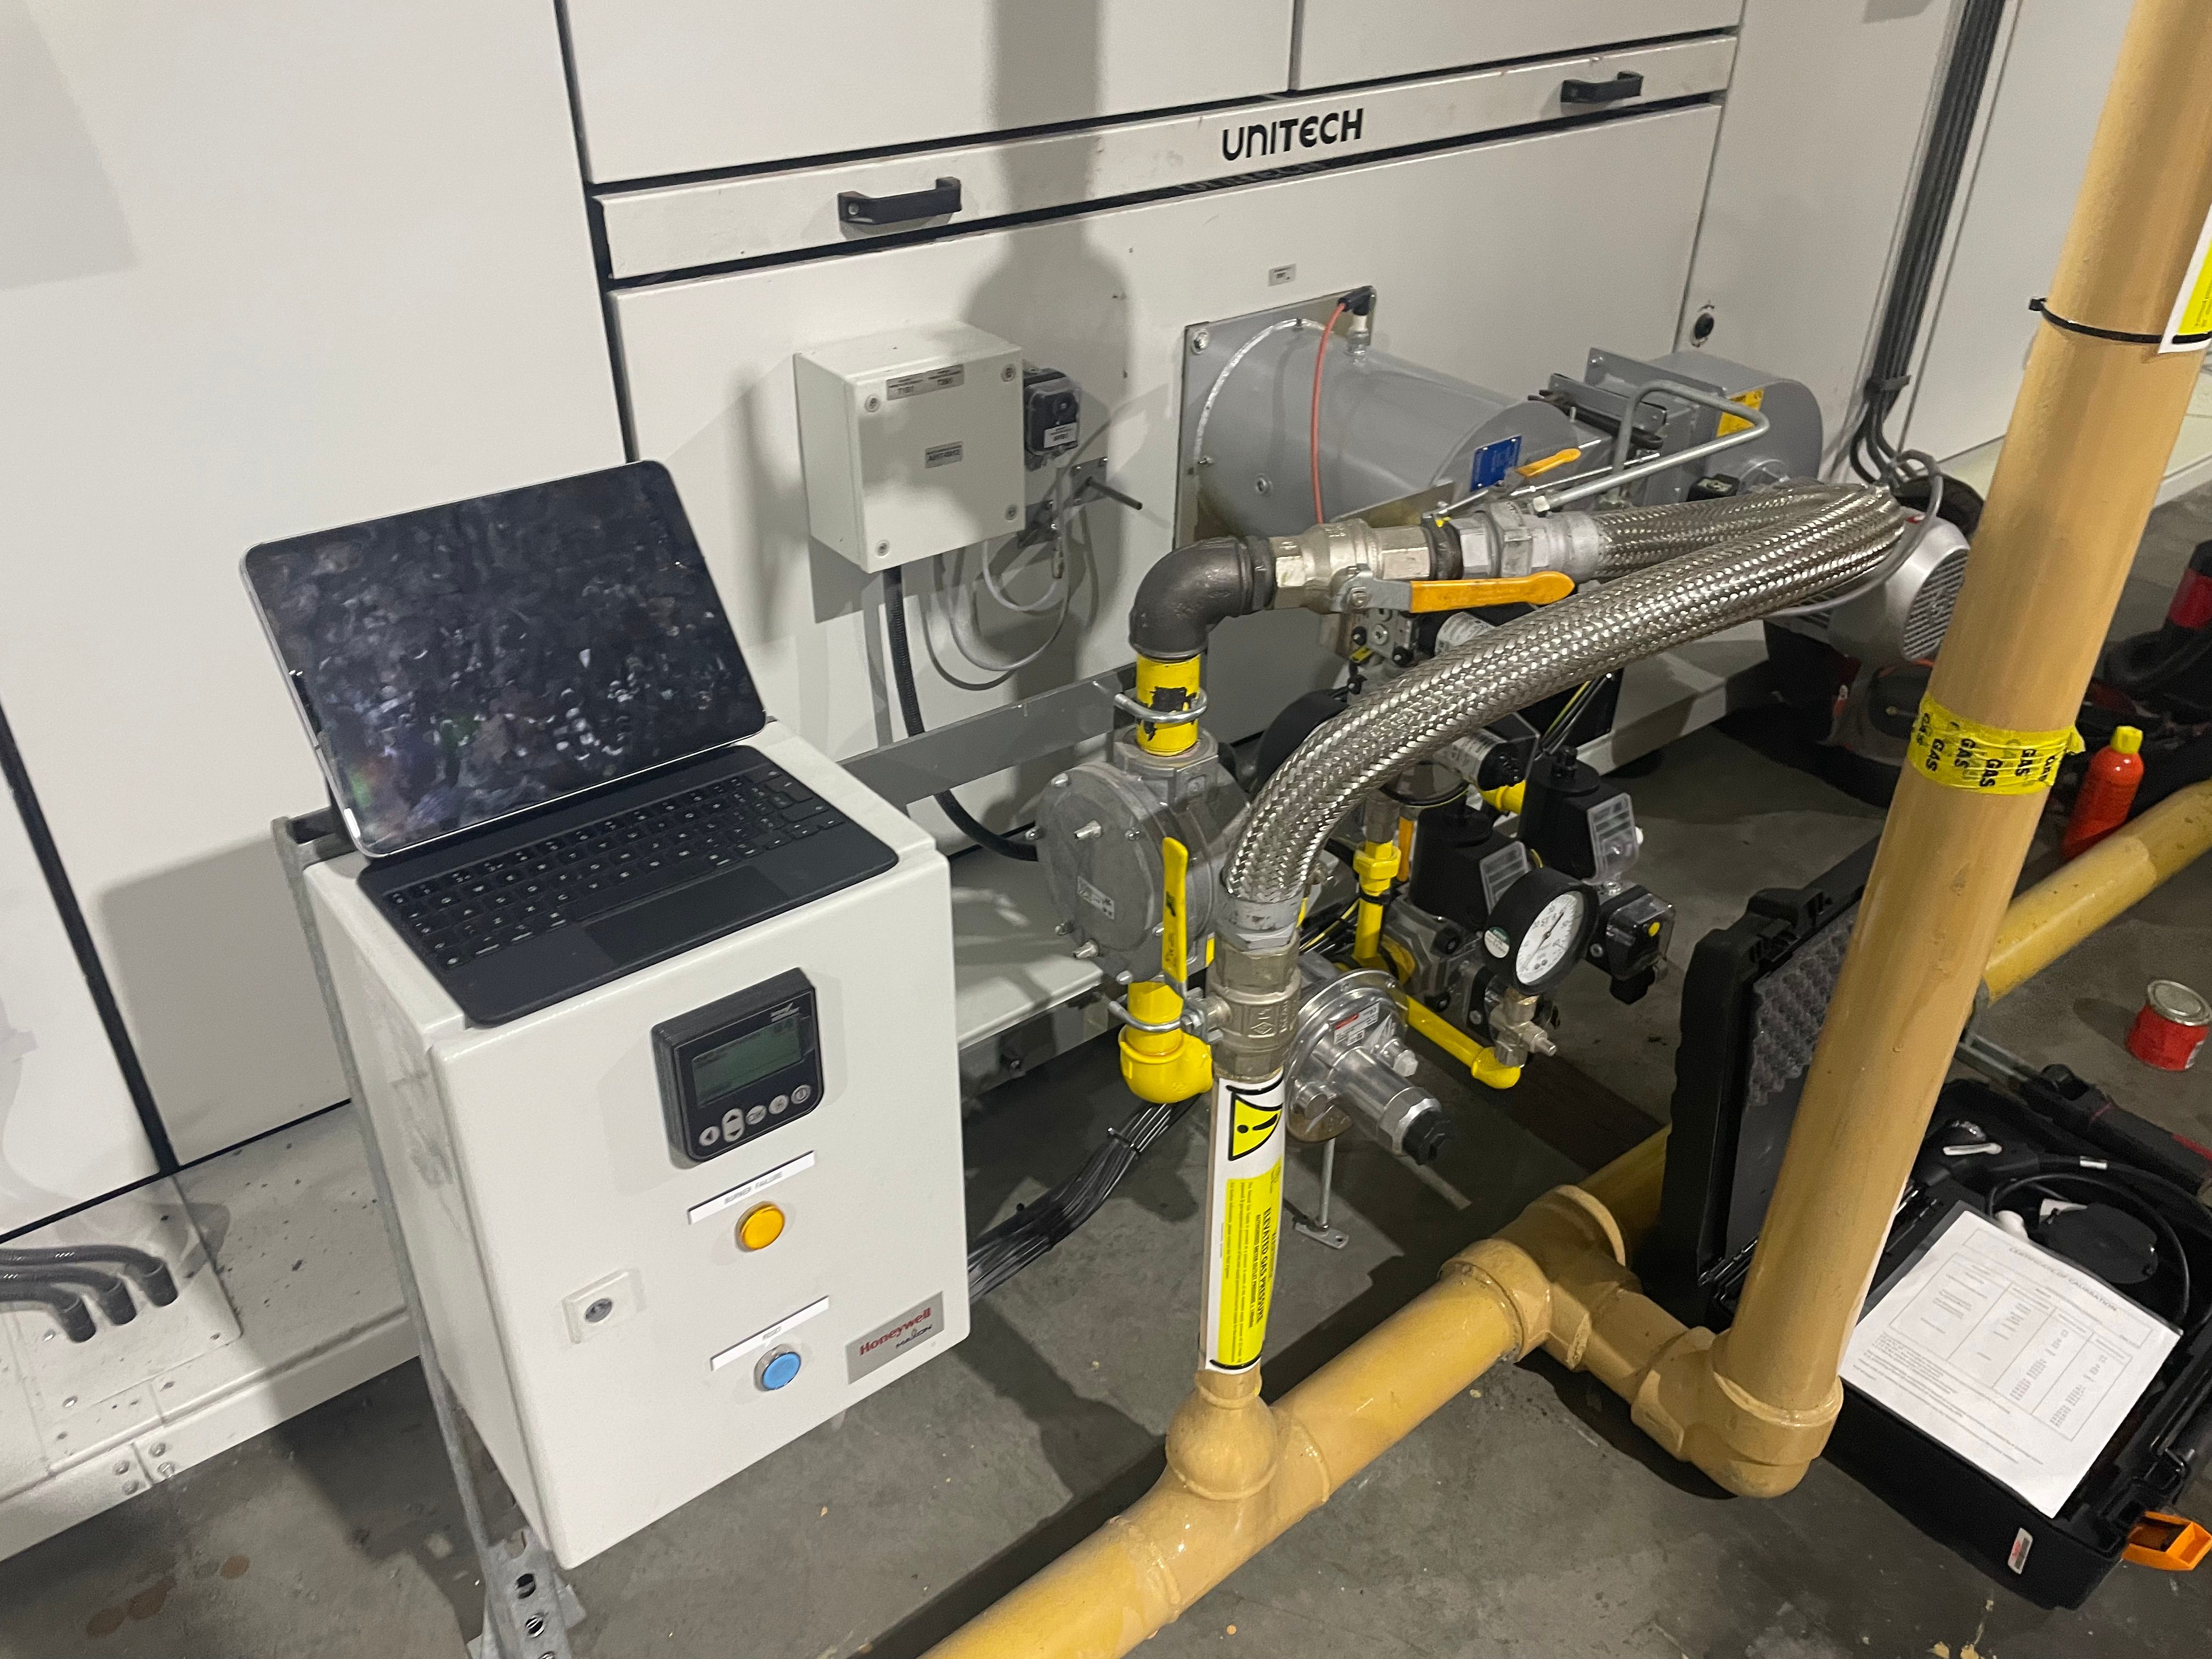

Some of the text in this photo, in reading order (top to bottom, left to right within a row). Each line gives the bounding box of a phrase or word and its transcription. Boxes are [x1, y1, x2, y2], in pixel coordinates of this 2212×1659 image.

[1926, 738, 1945, 772] GAS
[1954, 738, 1976, 768] GAS
[2015, 748, 2036, 777] GAS
[1979, 759, 2003, 787] GAS
[860, 1307, 932, 1356] Honeywell
